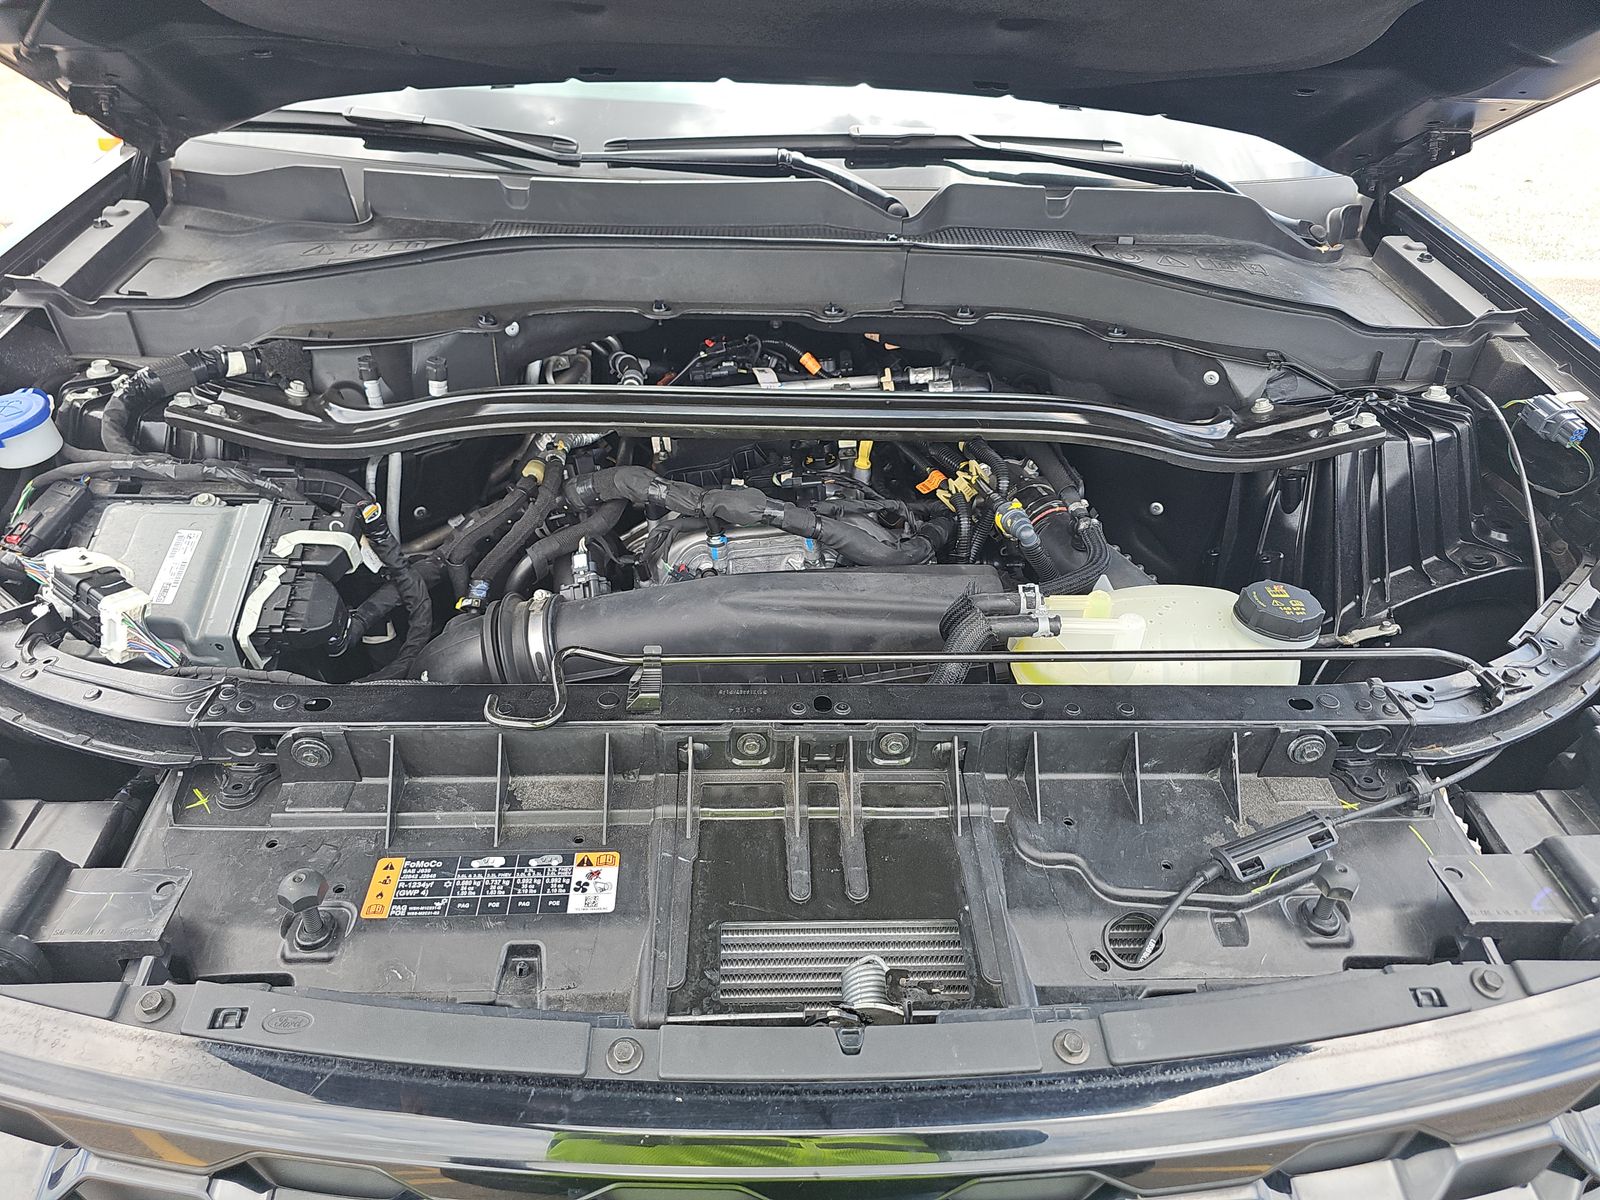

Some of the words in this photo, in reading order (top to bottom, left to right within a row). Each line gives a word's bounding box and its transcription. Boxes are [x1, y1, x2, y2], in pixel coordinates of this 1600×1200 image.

[404, 860, 443, 868] FoMoCo
[398, 881, 435, 889] R-1234yf
[472, 879, 482, 887] kg
[395, 889, 420, 897] (GWP
[420, 889, 429, 897] 4)
